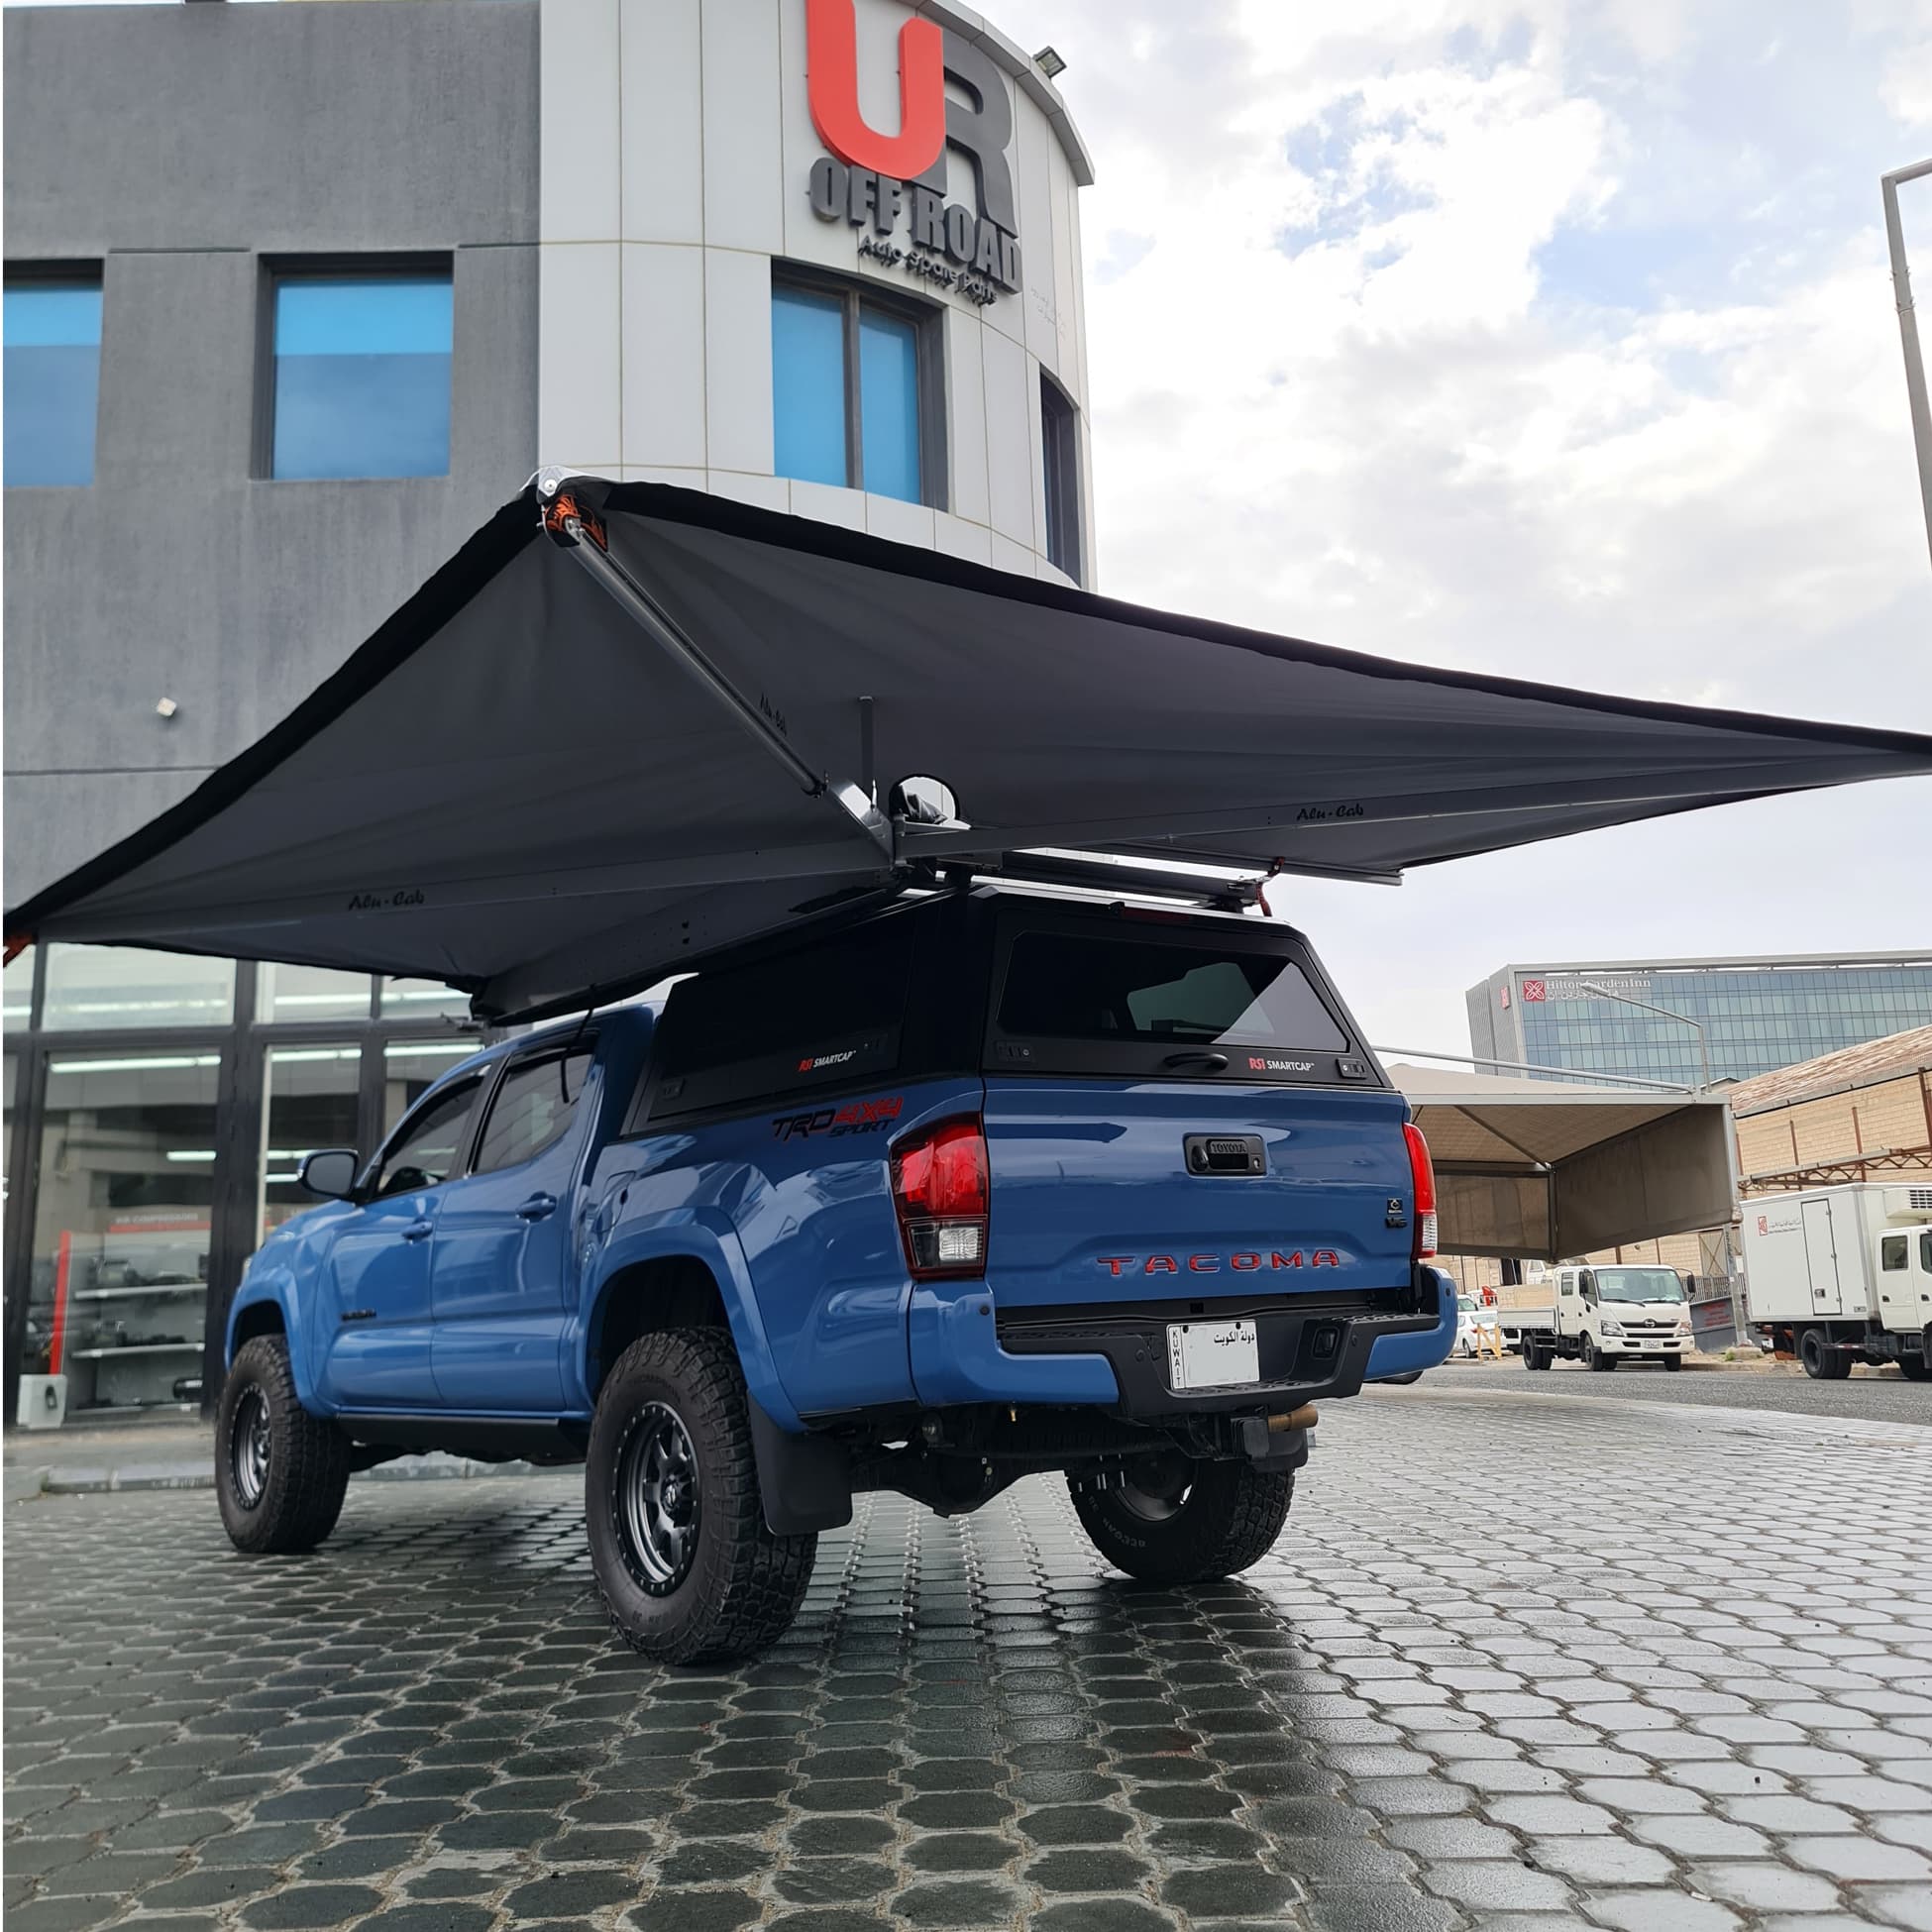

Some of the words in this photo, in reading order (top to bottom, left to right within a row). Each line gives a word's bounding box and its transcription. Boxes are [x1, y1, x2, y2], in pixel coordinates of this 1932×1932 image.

[808, 157, 903, 236] OFF
[907, 184, 1022, 294] ROAD
[858, 234, 904, 268] Auto
[904, 249, 957, 290] Spare
[954, 270, 998, 308] Parts
[1546, 979, 1582, 990] Hilton
[1630, 978, 1651, 988] Inn
[1248, 1057, 1266, 1070] RSI
[772, 1108, 837, 1142] TRD
[828, 1119, 896, 1138] SPORT
[1211, 1142, 1246, 1153] TOYOTA
[1097, 1248, 1341, 1276] TACOMA
[1213, 1331, 1239, 1346] الكويت
[1240, 1330, 1255, 1344] دولة
[1172, 1329, 1181, 1386] KUWAIT
